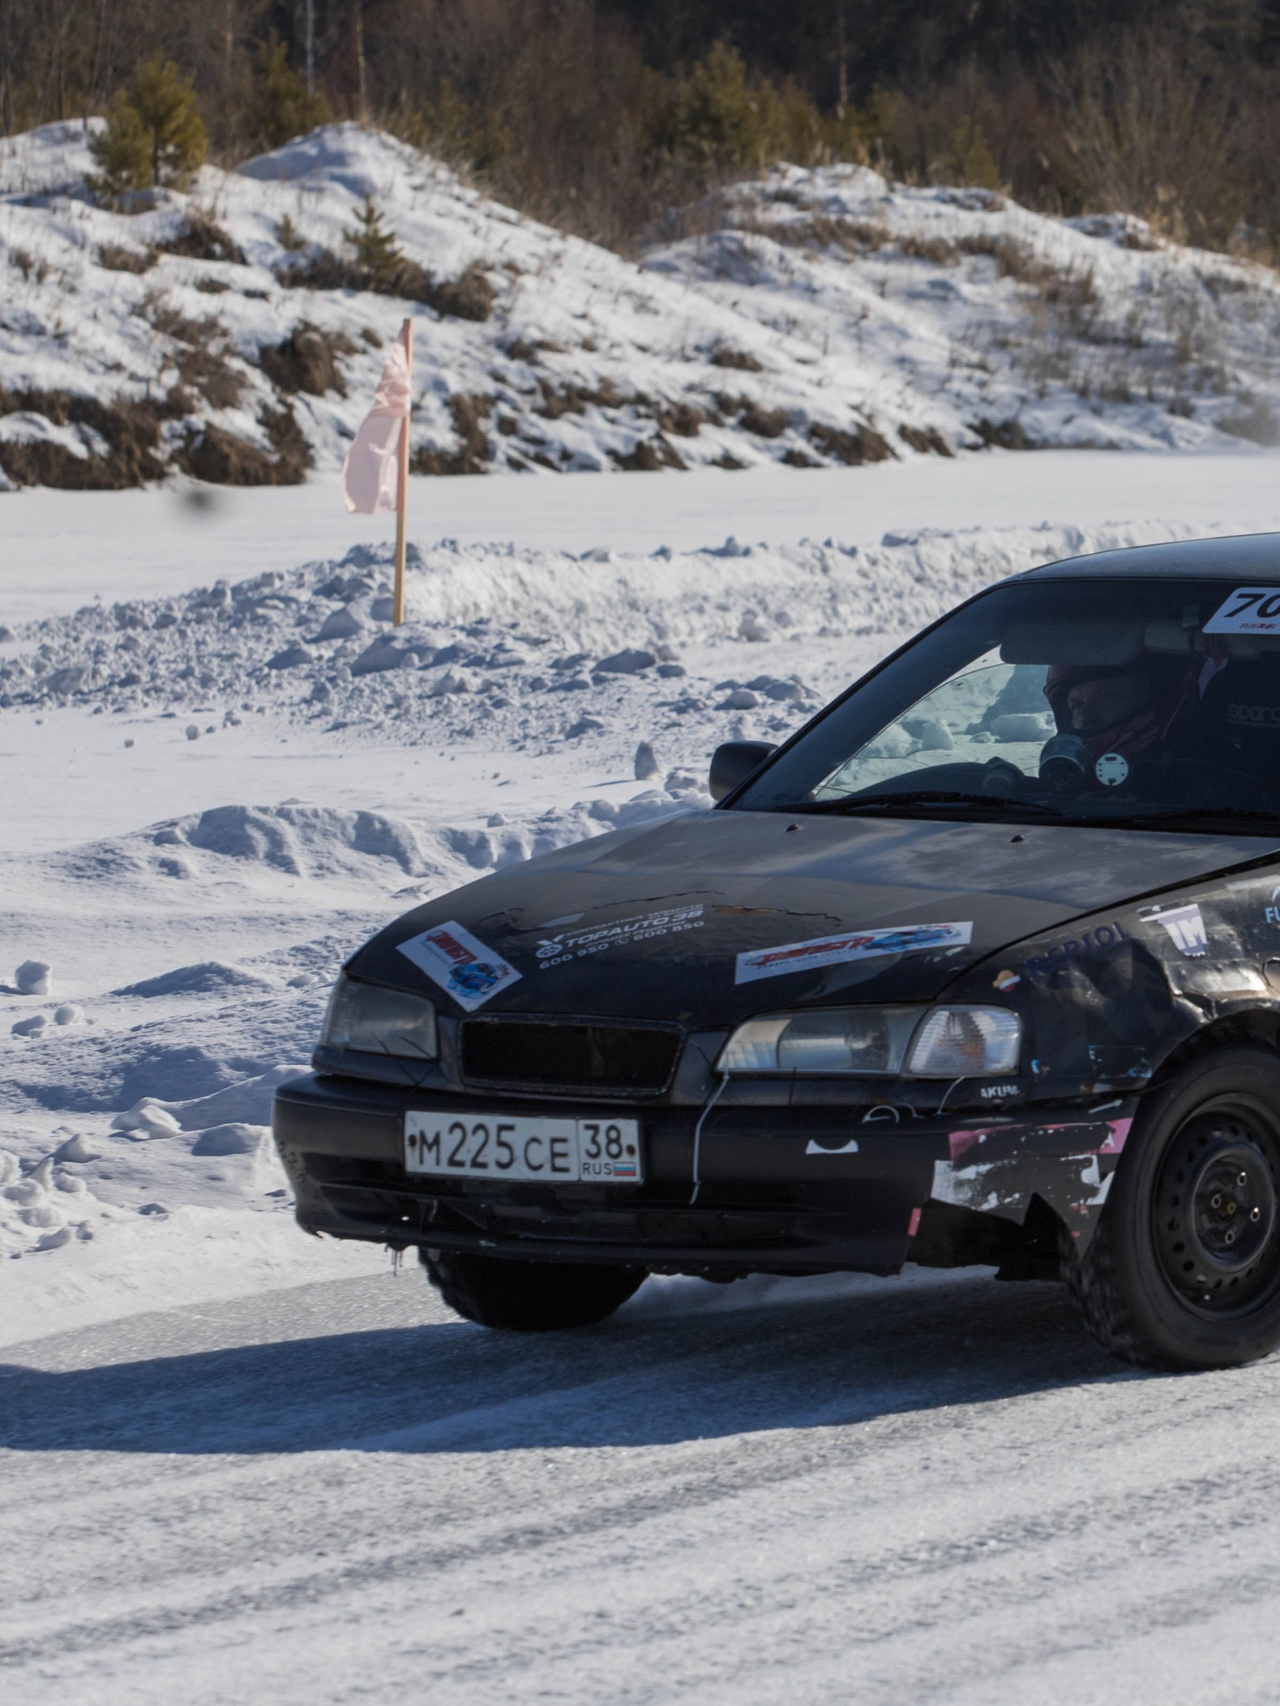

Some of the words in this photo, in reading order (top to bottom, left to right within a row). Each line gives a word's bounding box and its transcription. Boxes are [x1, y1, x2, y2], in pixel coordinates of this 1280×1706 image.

[539, 954, 573, 970] 600
[577, 943, 609, 957] 950
[633, 929, 667, 941] 600
[672, 920, 704, 932] 850
[583, 1124, 623, 1160] 38
[583, 1163, 612, 1175] RUS
